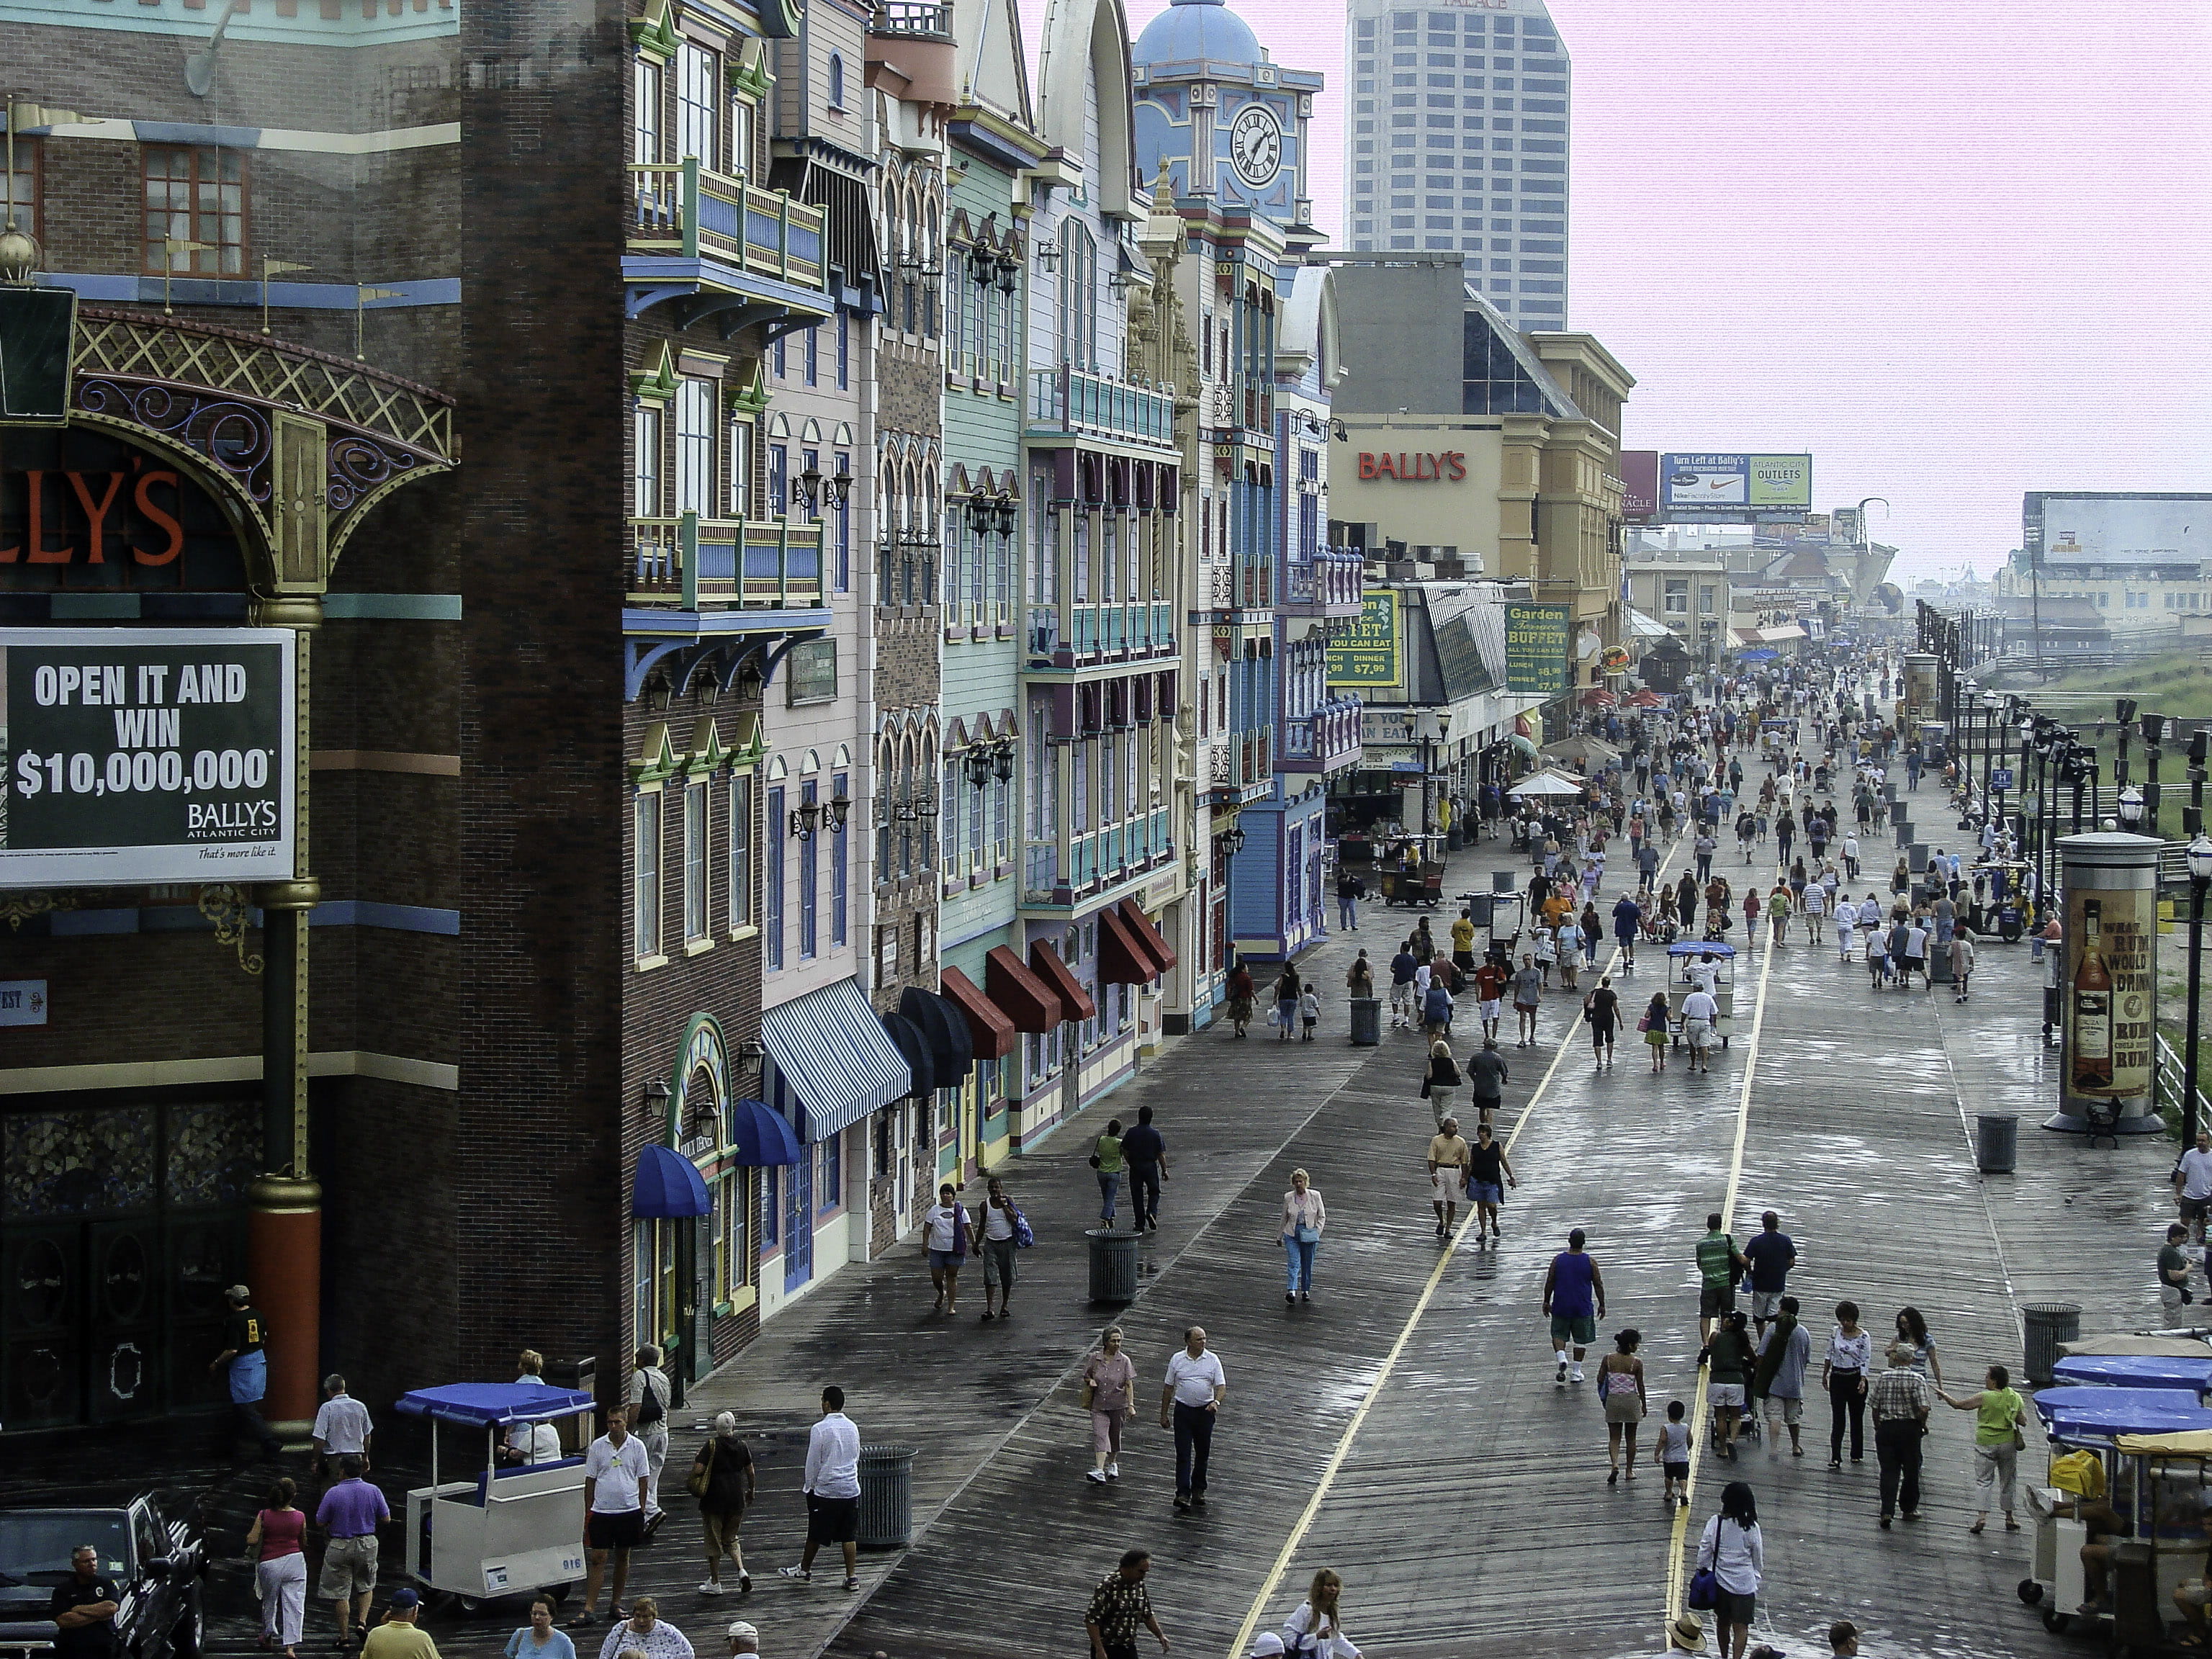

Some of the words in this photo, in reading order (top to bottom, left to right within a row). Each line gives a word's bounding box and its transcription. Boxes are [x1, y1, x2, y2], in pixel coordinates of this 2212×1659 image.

[1358, 451, 1467, 480] BALLY'S
[1673, 455, 1689, 465] Turn
[1691, 455, 1706, 465] Left
[1708, 456, 1716, 465] at
[1718, 455, 1744, 467] Bally's
[1758, 469, 1801, 480] OUTLETS
[1510, 608, 1563, 619] Garden
[1509, 631, 1566, 644] BUFFET
[1354, 664, 1385, 675] $7.99
[35, 665, 125, 706] OPEN
[138, 665, 168, 704] IT
[176, 664, 246, 703] AND
[114, 709, 180, 748] WIN
[1382, 727, 1406, 738] EAT
[188, 799, 276, 829] BALLY'S
[187, 829, 246, 838] ATLANTIC
[251, 827, 276, 836] CITY
[199, 847, 225, 859] That's
[251, 846, 266, 858] like
[268, 846, 276, 856] it.
[2104, 922, 2140, 933] WHAT
[2114, 935, 2149, 951] RUM
[2108, 954, 2146, 970] WOULD
[0, 990, 22, 1009] EST
[2116, 1022, 2149, 1039] RUM
[2115, 1051, 2148, 1069] RUM
